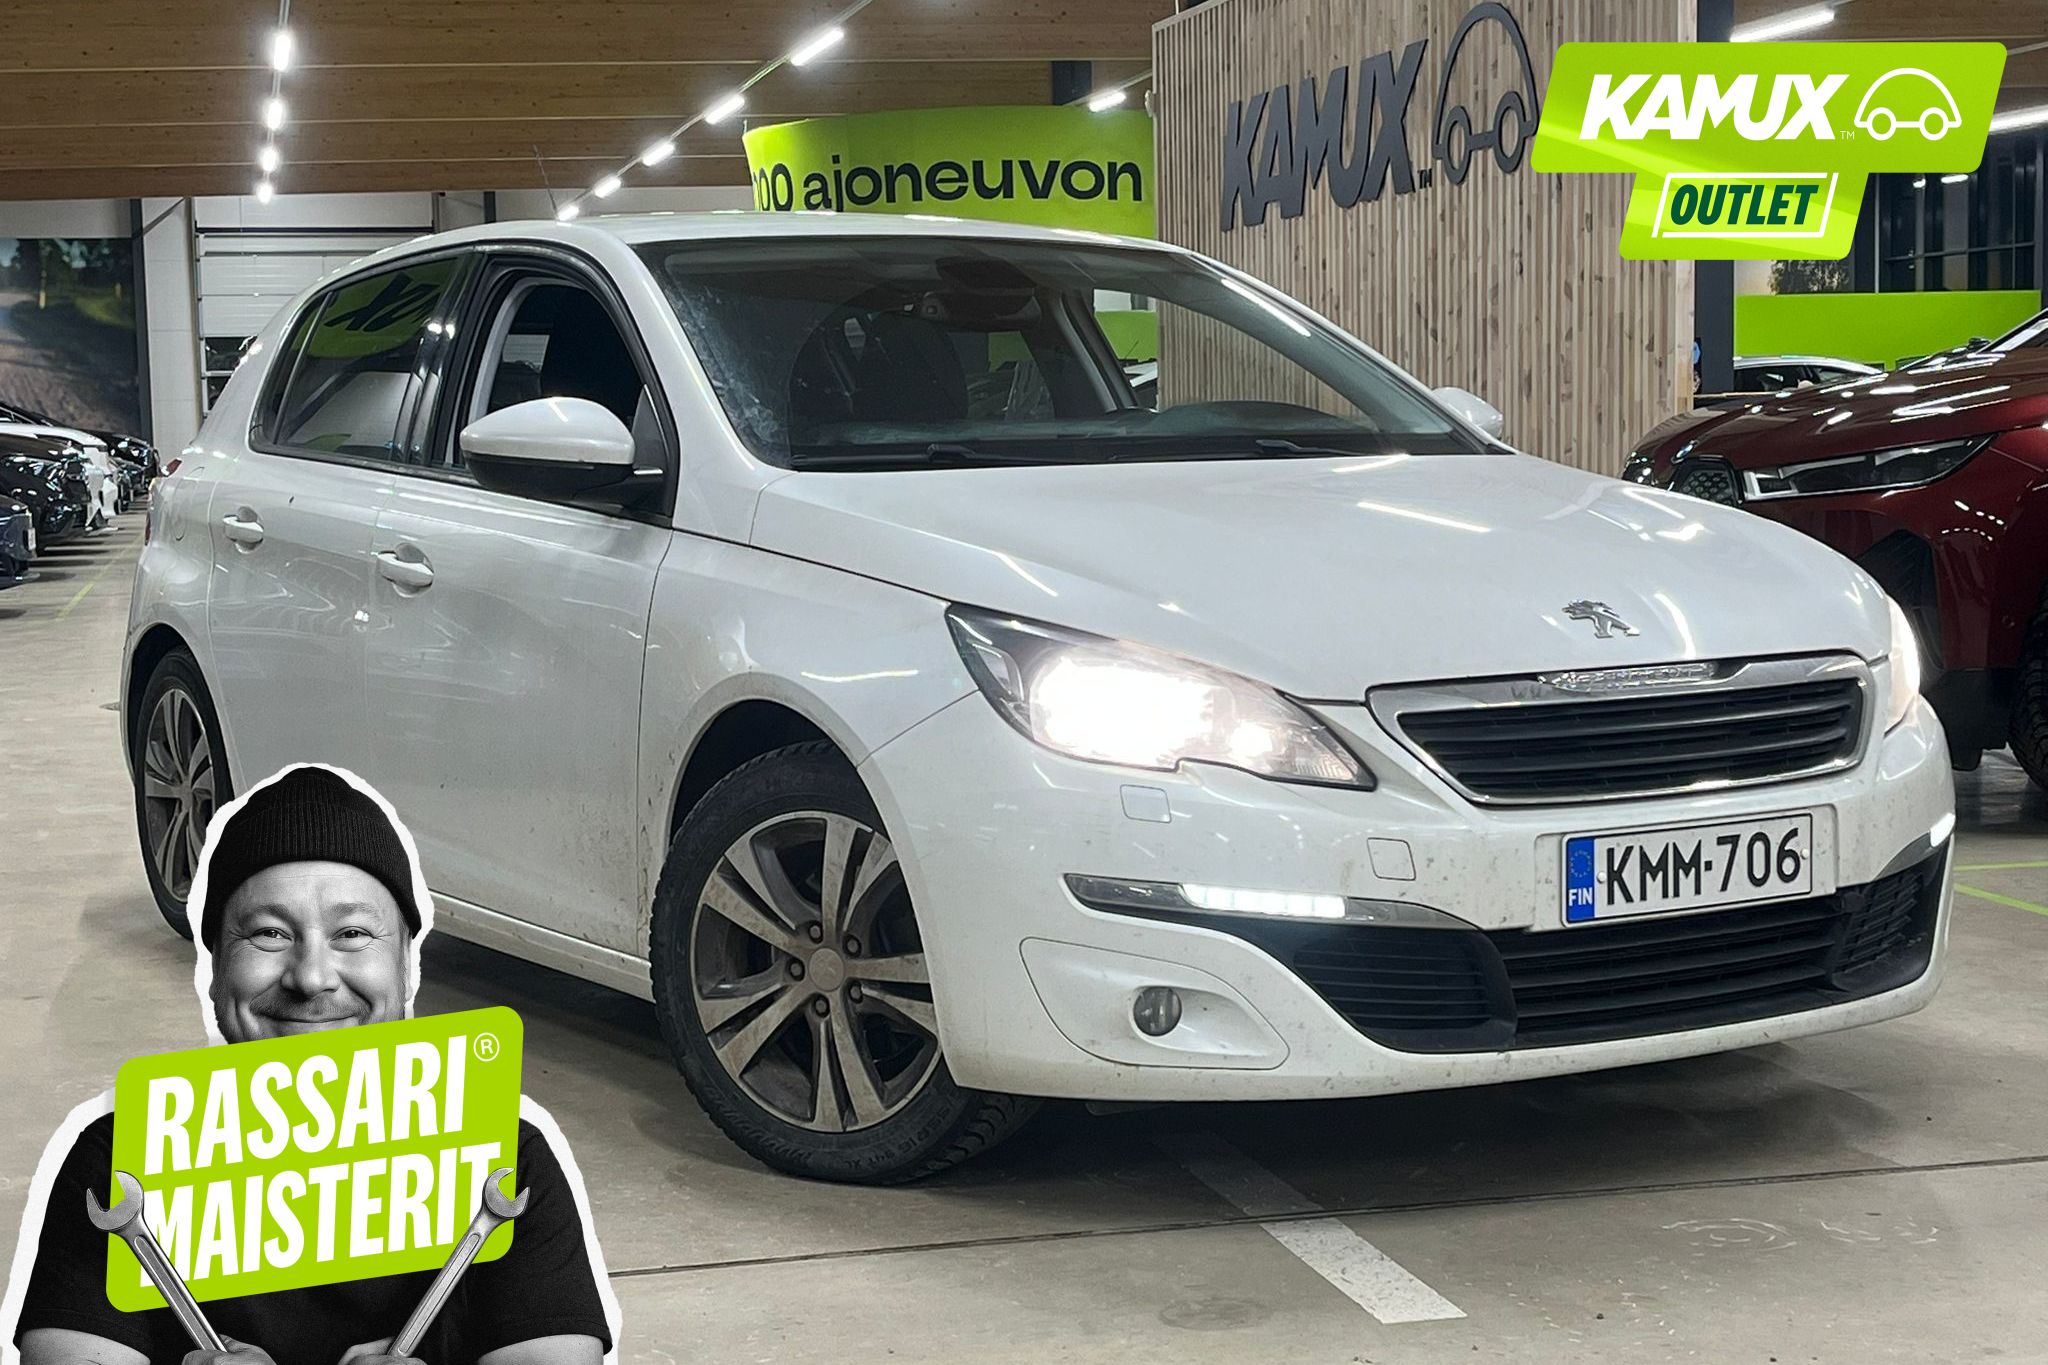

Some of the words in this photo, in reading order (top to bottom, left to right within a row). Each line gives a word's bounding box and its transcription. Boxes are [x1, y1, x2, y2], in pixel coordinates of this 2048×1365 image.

[1221, 39, 1428, 232] KAMUX
[803, 154, 1143, 212] ajoneuvon
[1568, 886, 1594, 907] FIN
[1606, 827, 1800, 906] KMM-706
